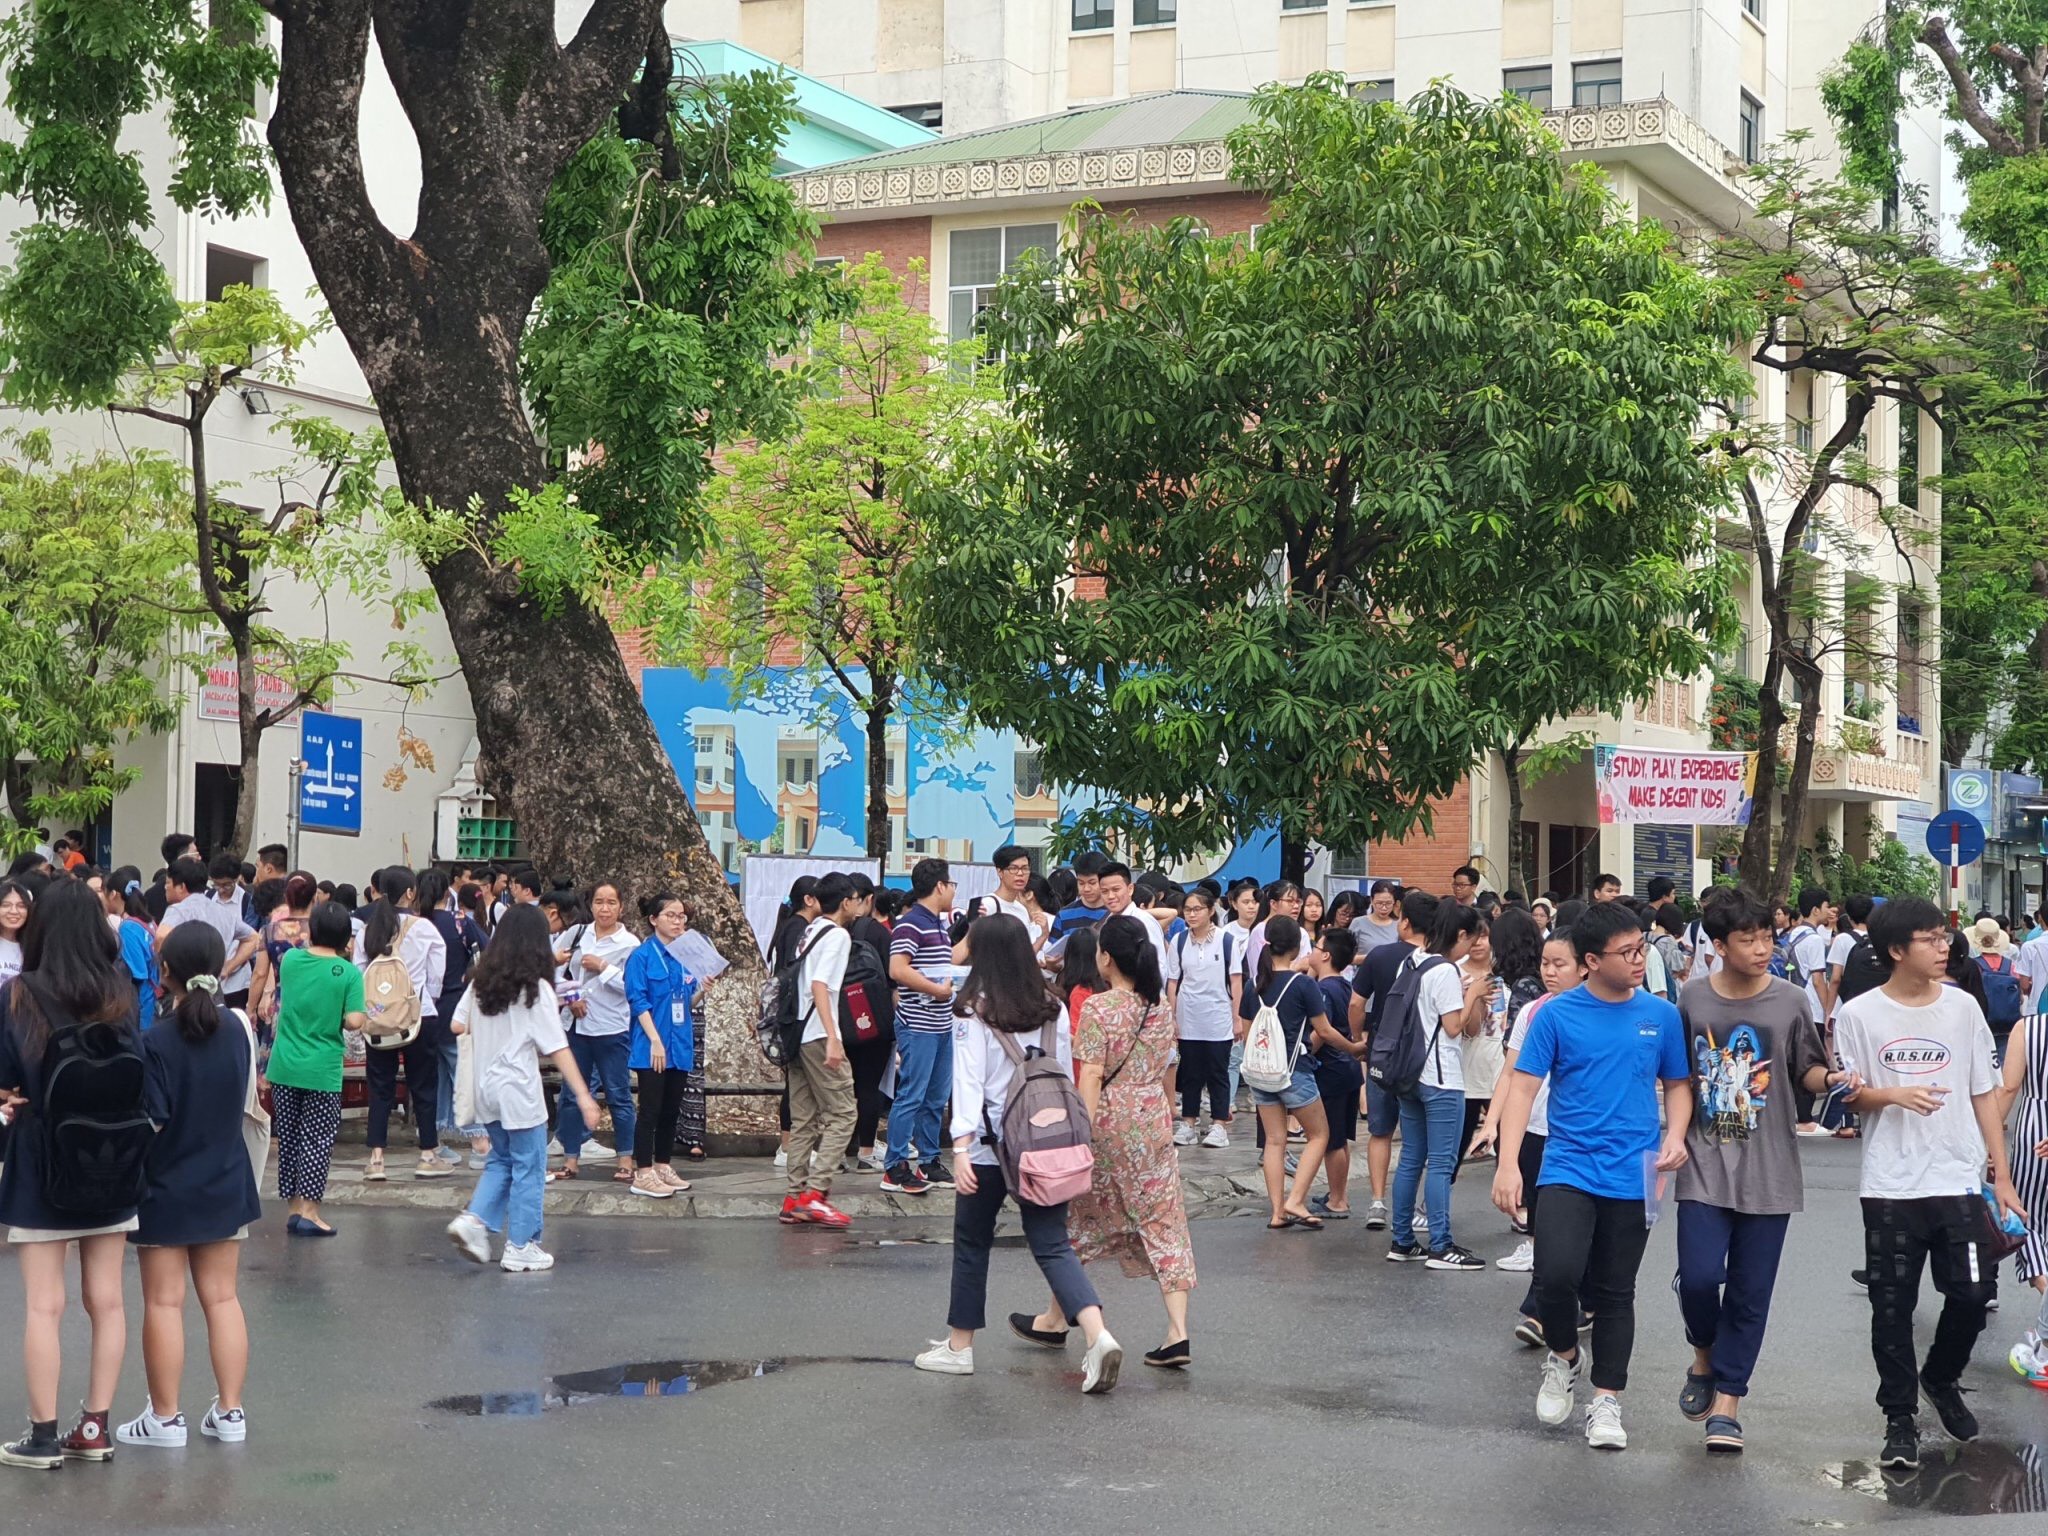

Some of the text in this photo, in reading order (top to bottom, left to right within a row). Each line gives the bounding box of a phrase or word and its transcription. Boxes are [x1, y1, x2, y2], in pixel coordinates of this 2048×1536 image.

[1613, 755, 1741, 782] STUDY, PLAY, EXPERIENCE
[1628, 785, 1727, 809] MAKE DECENT KIDS!
